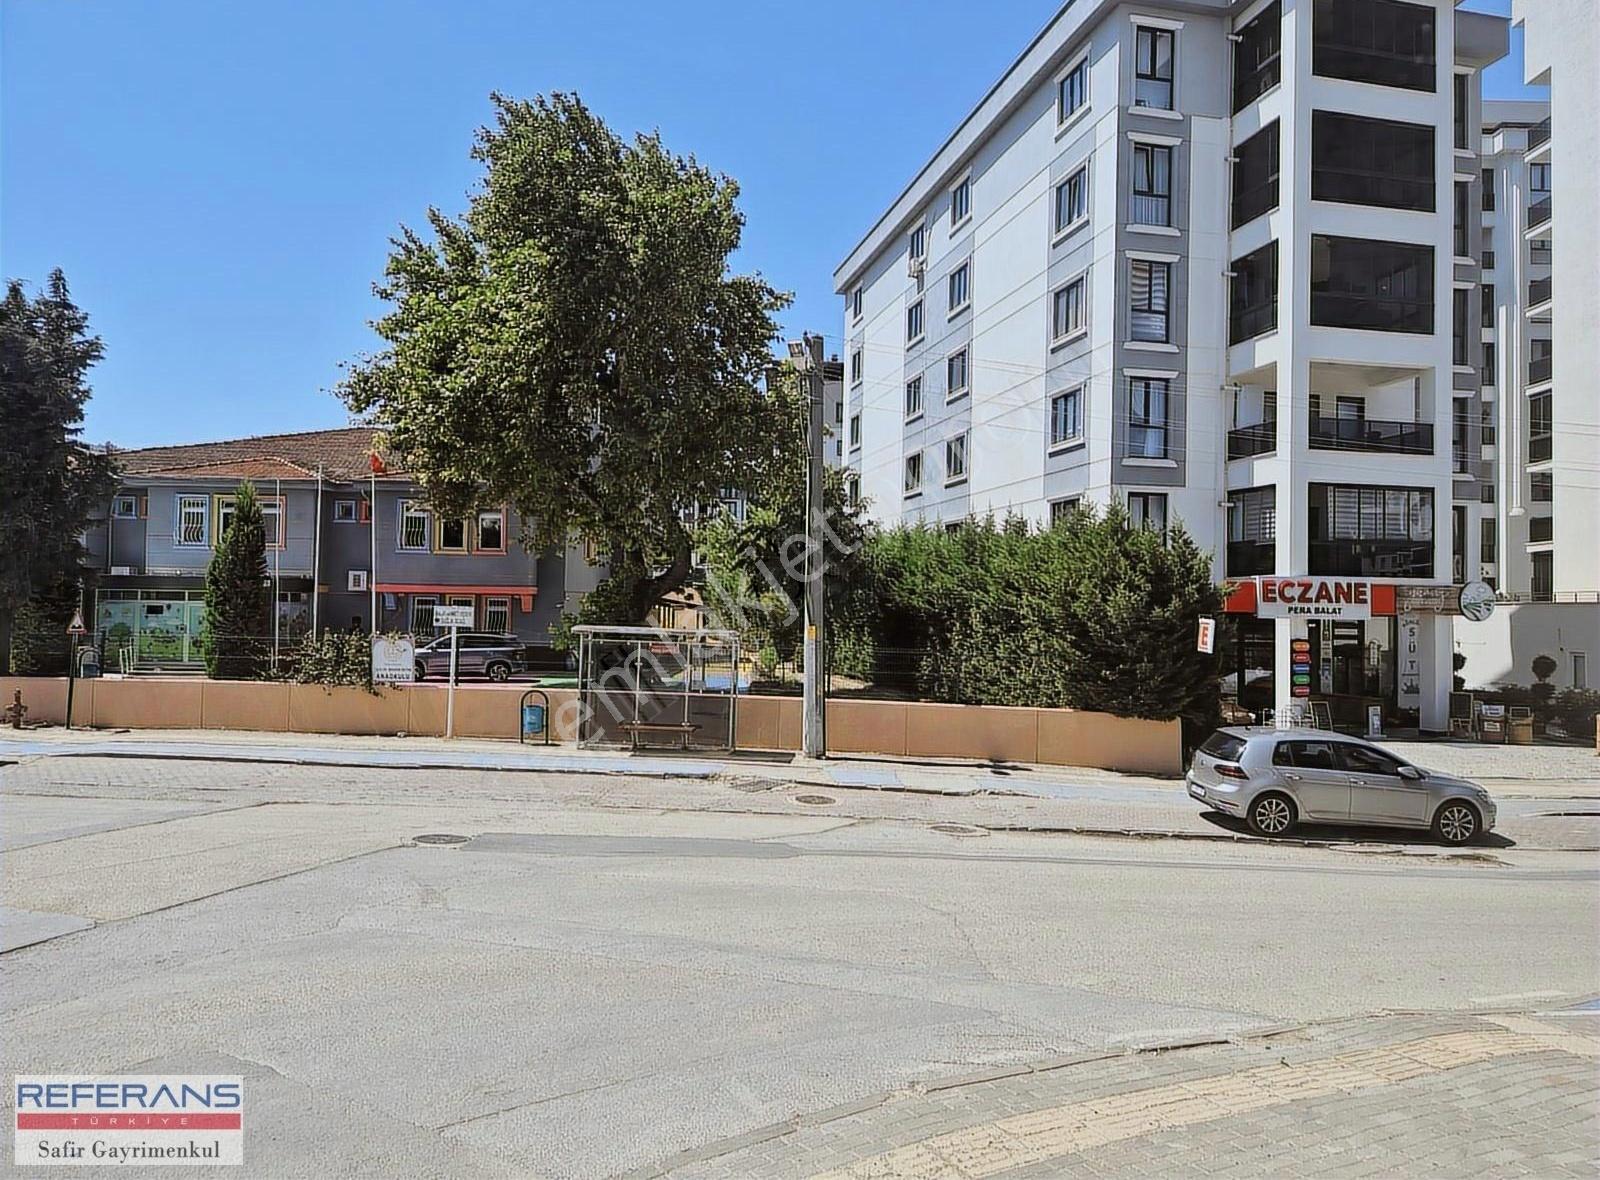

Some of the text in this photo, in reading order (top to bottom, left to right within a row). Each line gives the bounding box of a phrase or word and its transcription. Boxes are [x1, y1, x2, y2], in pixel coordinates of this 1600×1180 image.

[1261, 580, 1368, 604] ECZANE
[1288, 606, 1342, 615] PERA BALAT
[1200, 626, 1209, 646] E
